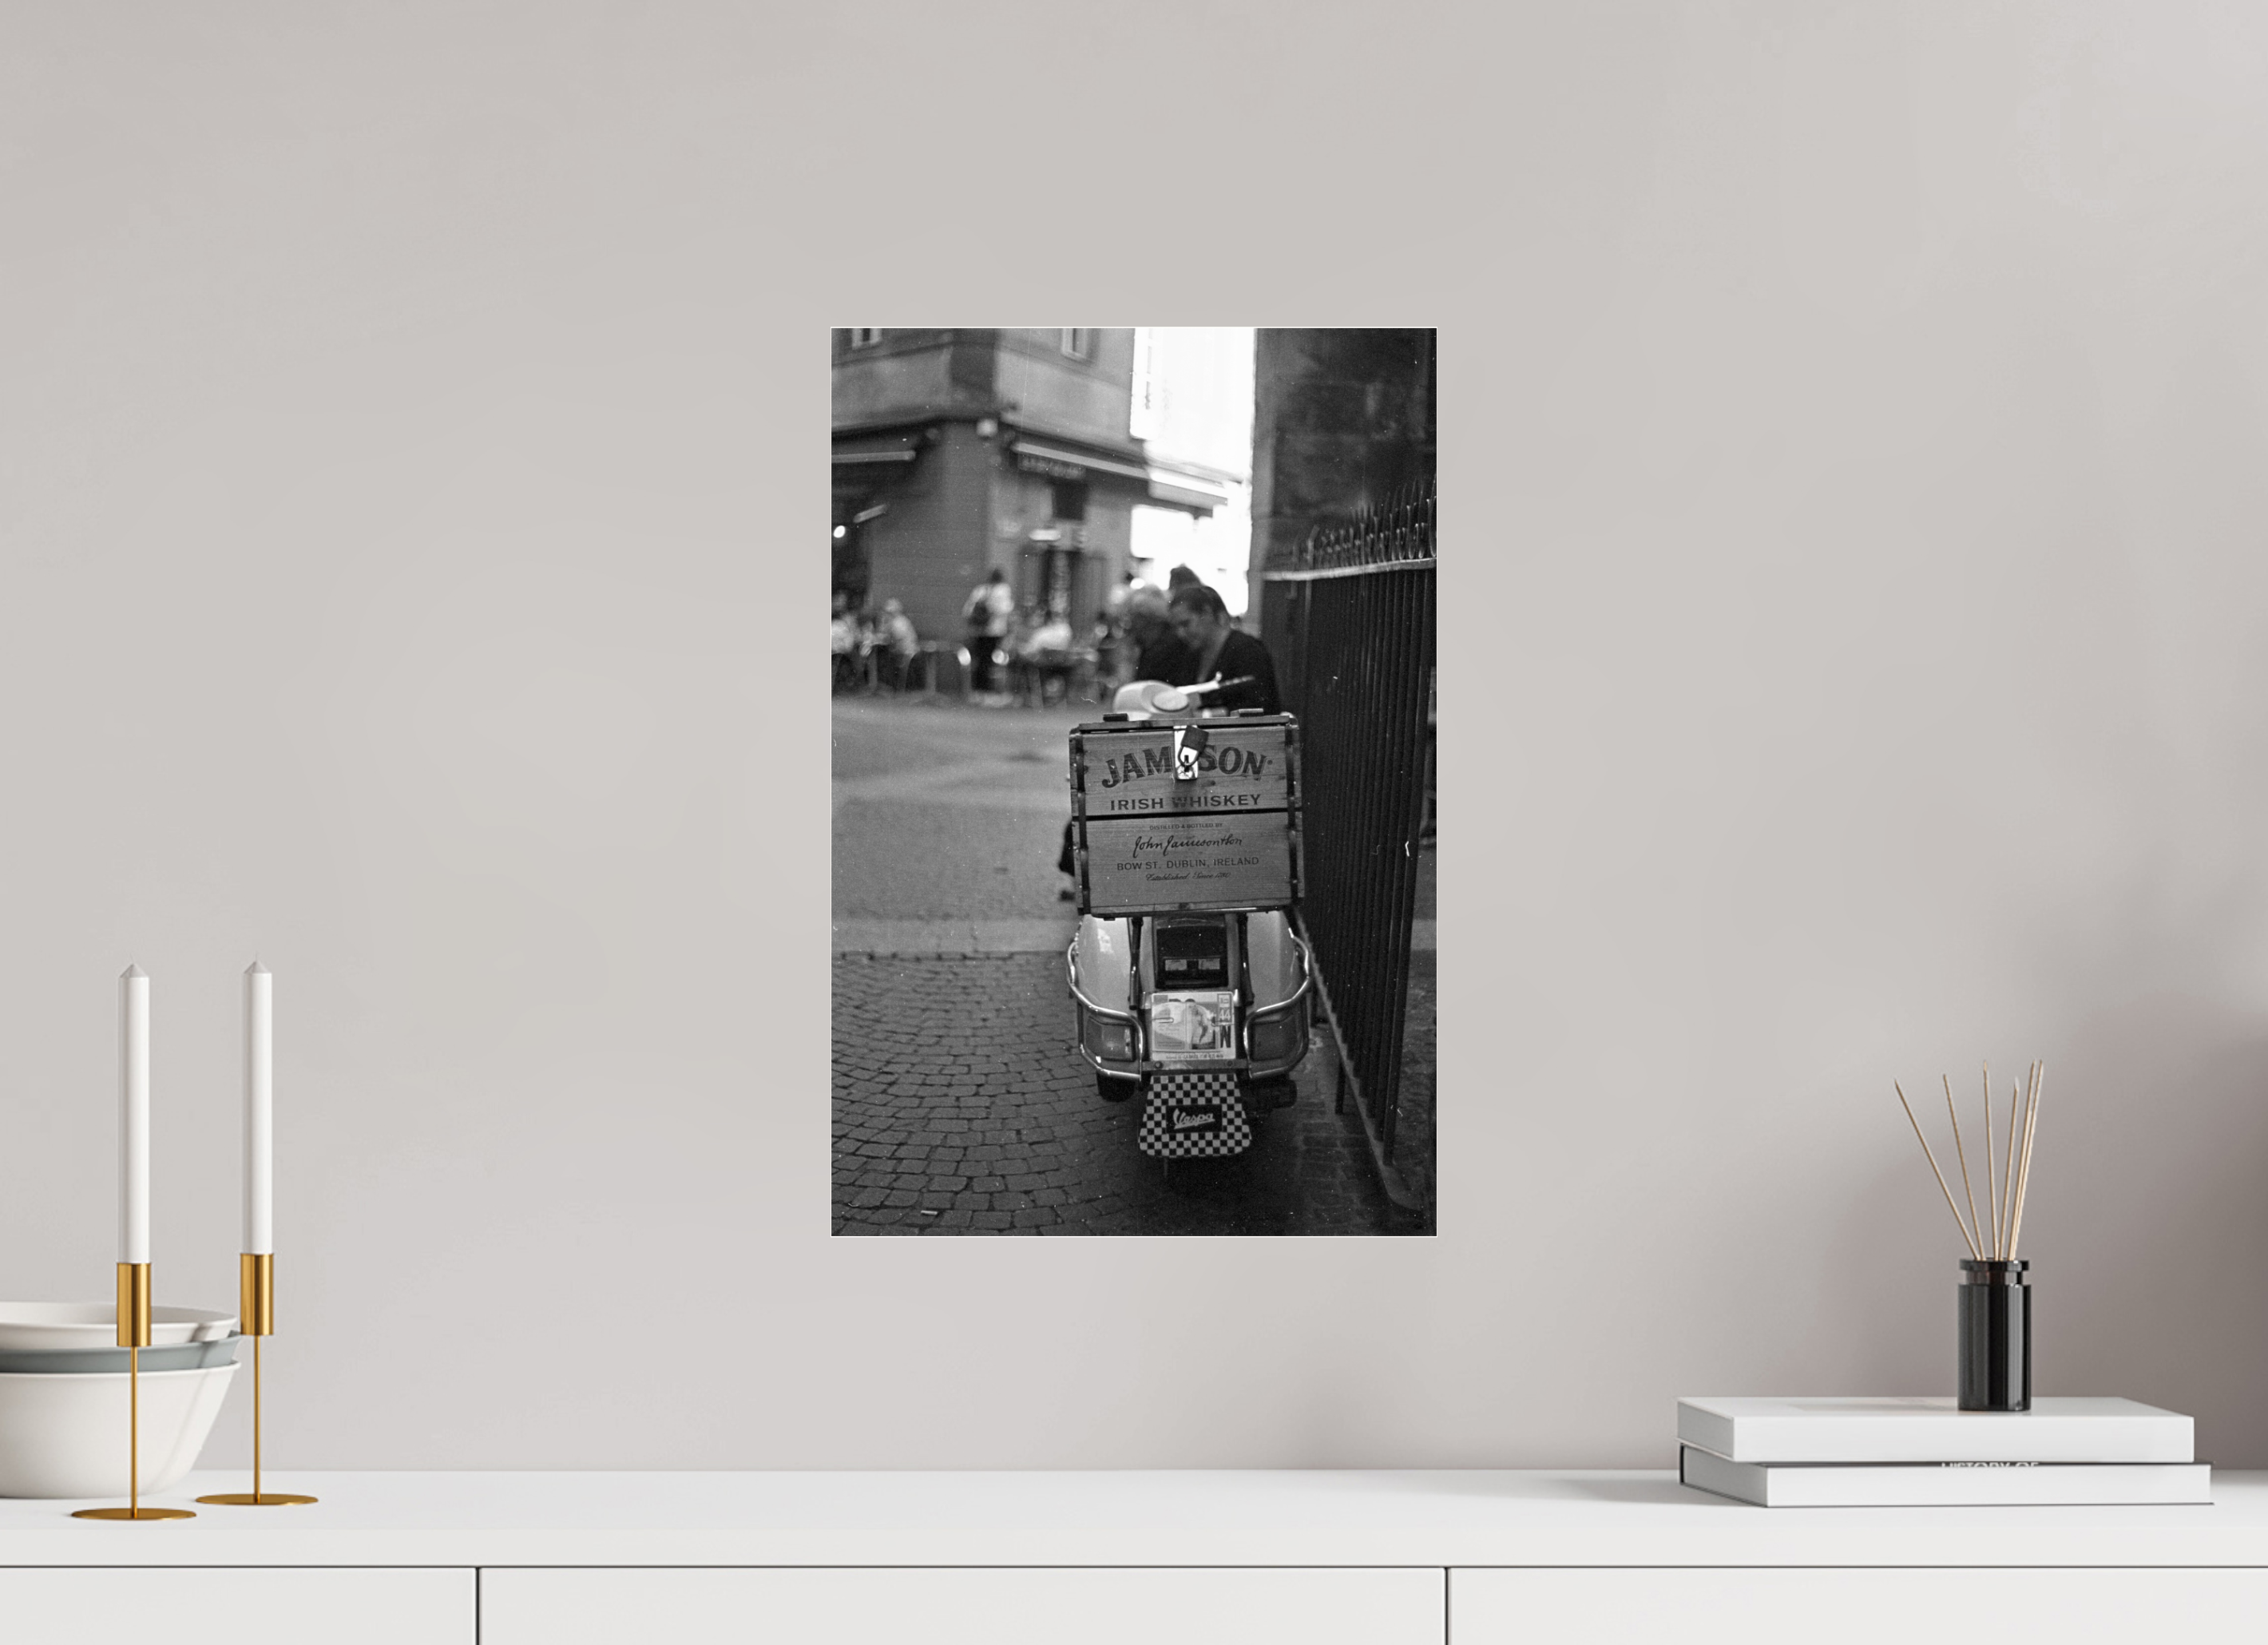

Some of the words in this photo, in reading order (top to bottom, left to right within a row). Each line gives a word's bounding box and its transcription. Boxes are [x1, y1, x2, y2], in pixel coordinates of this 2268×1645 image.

[1101, 744, 1267, 788] JAMSON
[1110, 798, 1164, 811] IRISH
[1172, 794, 1262, 809] WHISKEY
[1132, 835, 1163, 858] John
[1117, 862, 1142, 871] BOW
[1145, 861, 1161, 870] ST.
[1167, 859, 1210, 869] DUBLIN,
[1213, 857, 1259, 866] IRELAND
[1145, 872, 1190, 882] Established
[1172, 1108, 1215, 1128] Vespa
